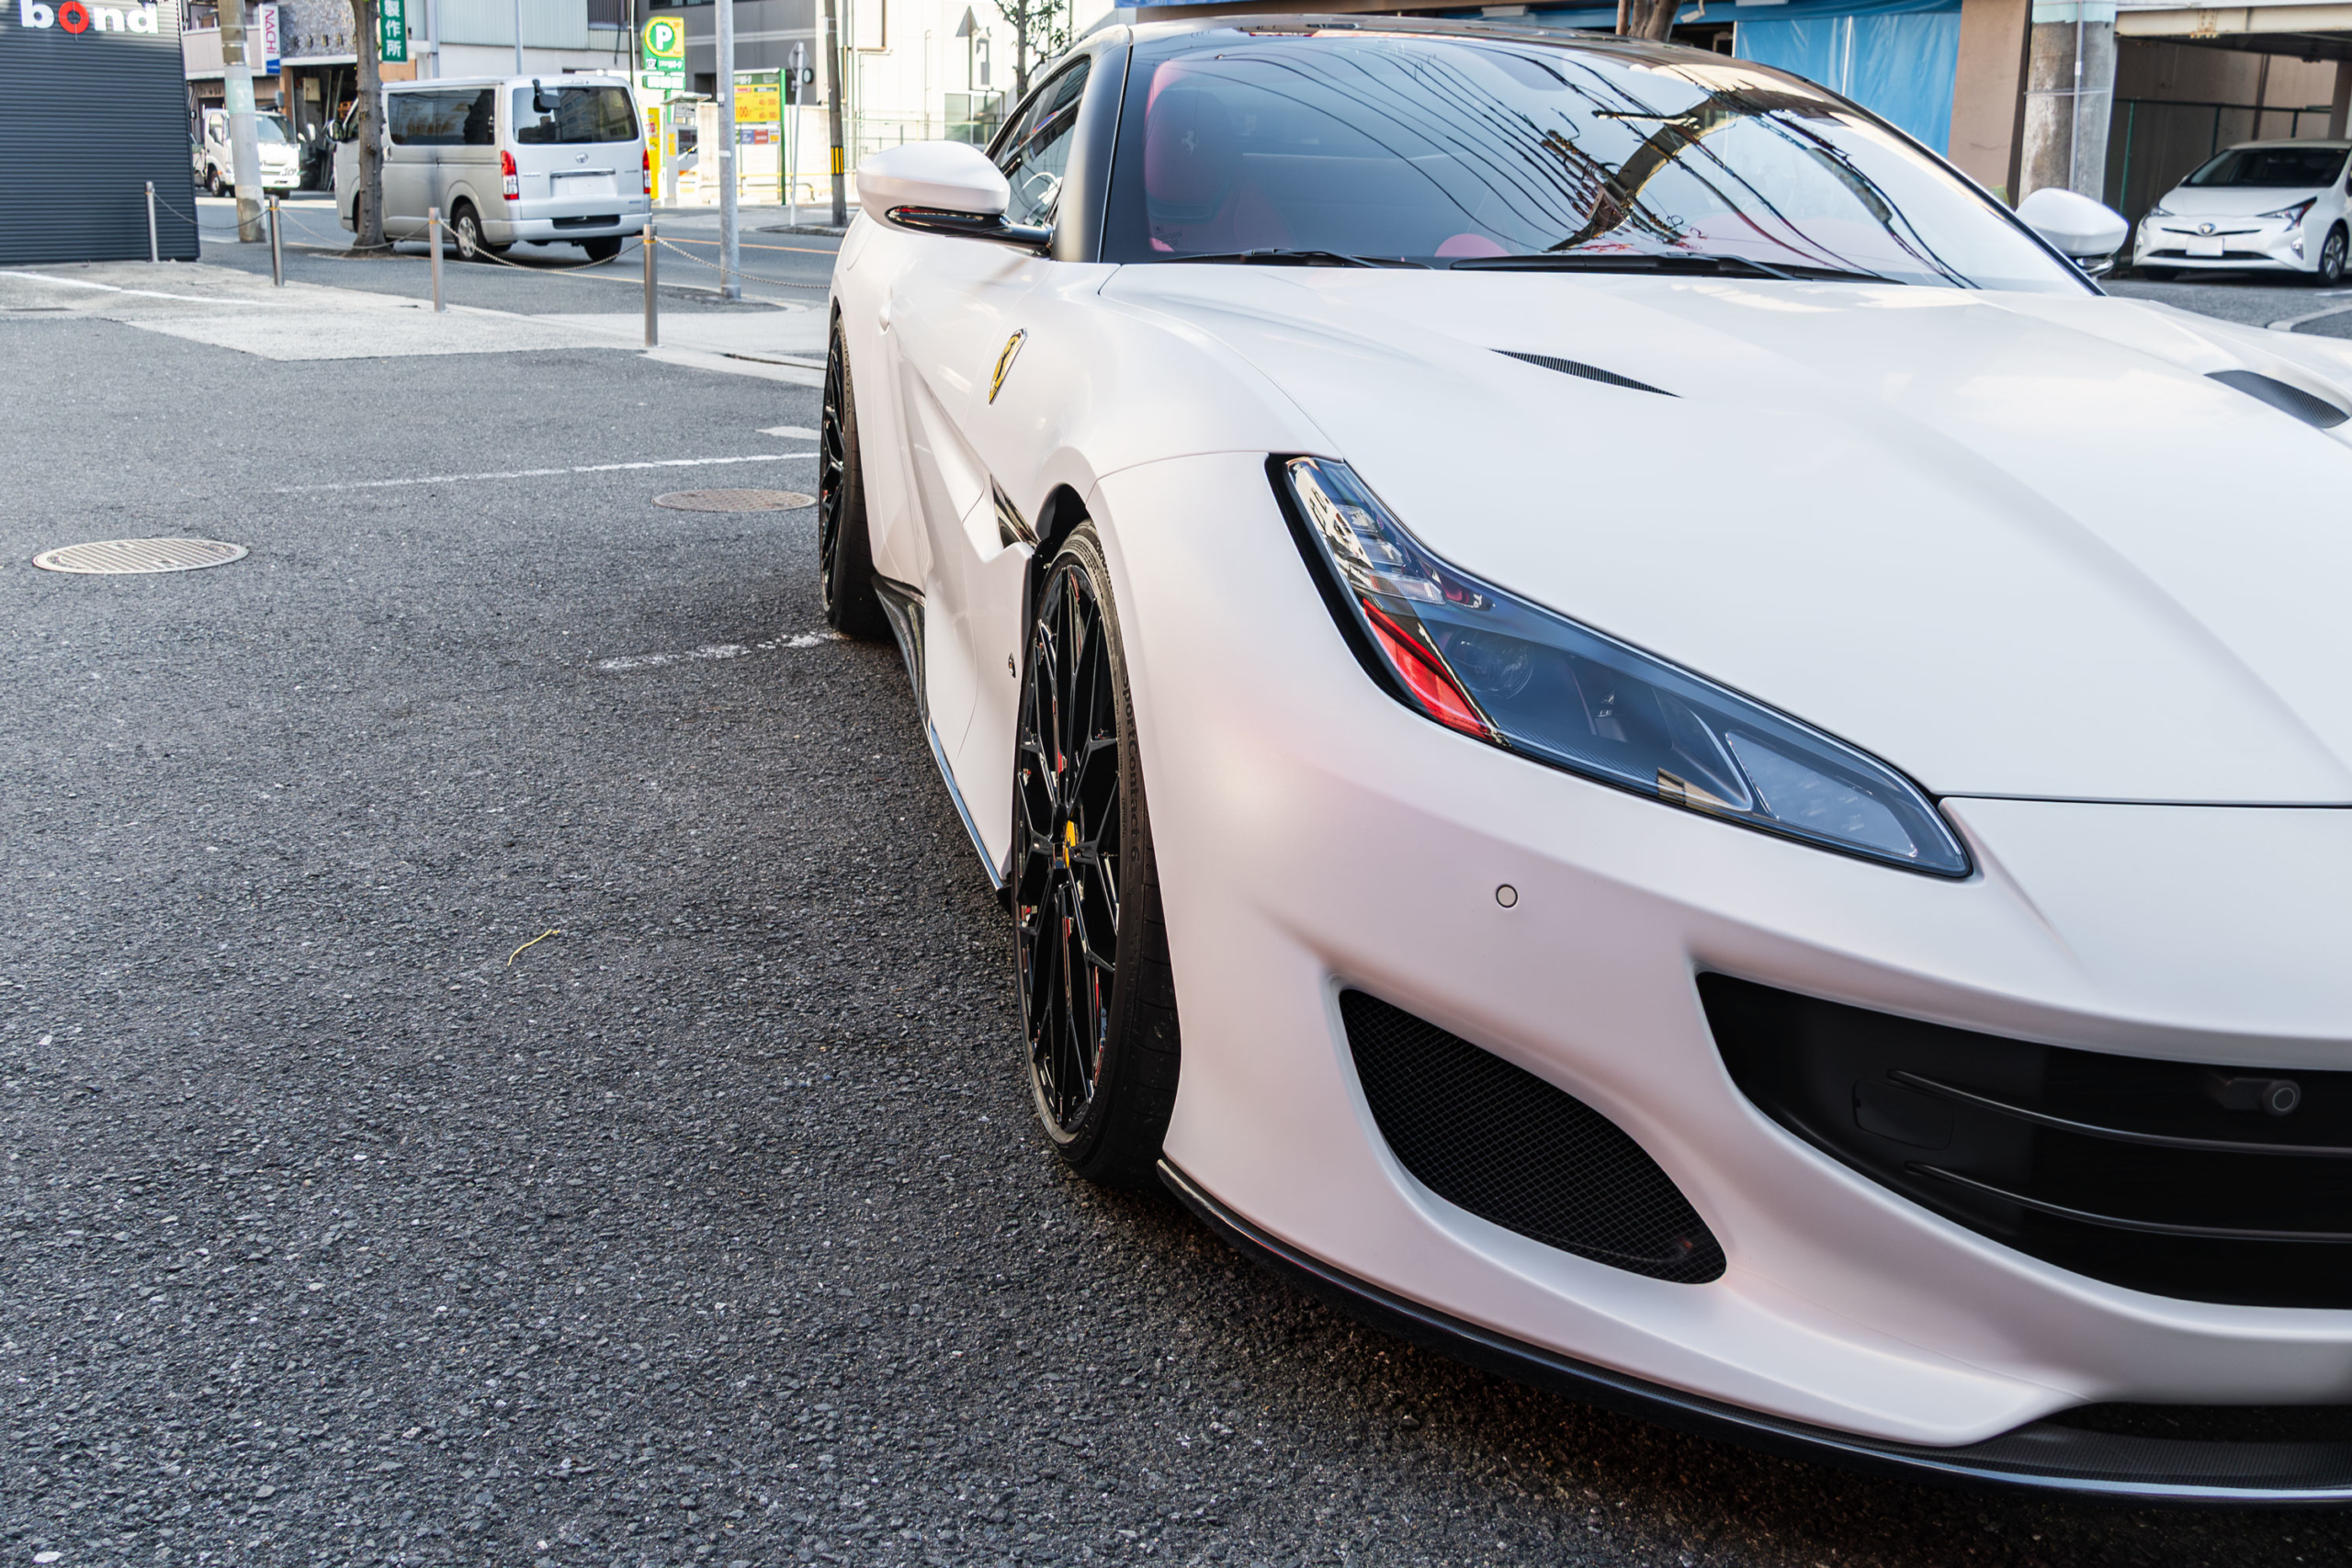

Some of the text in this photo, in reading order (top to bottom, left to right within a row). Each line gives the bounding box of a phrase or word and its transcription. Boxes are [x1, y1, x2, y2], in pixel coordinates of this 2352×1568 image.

[20, 0, 159, 34] bond
[384, 0, 401, 58] 製作所
[655, 25, 673, 51] P
[1123, 675, 1140, 862] SportContact 6
